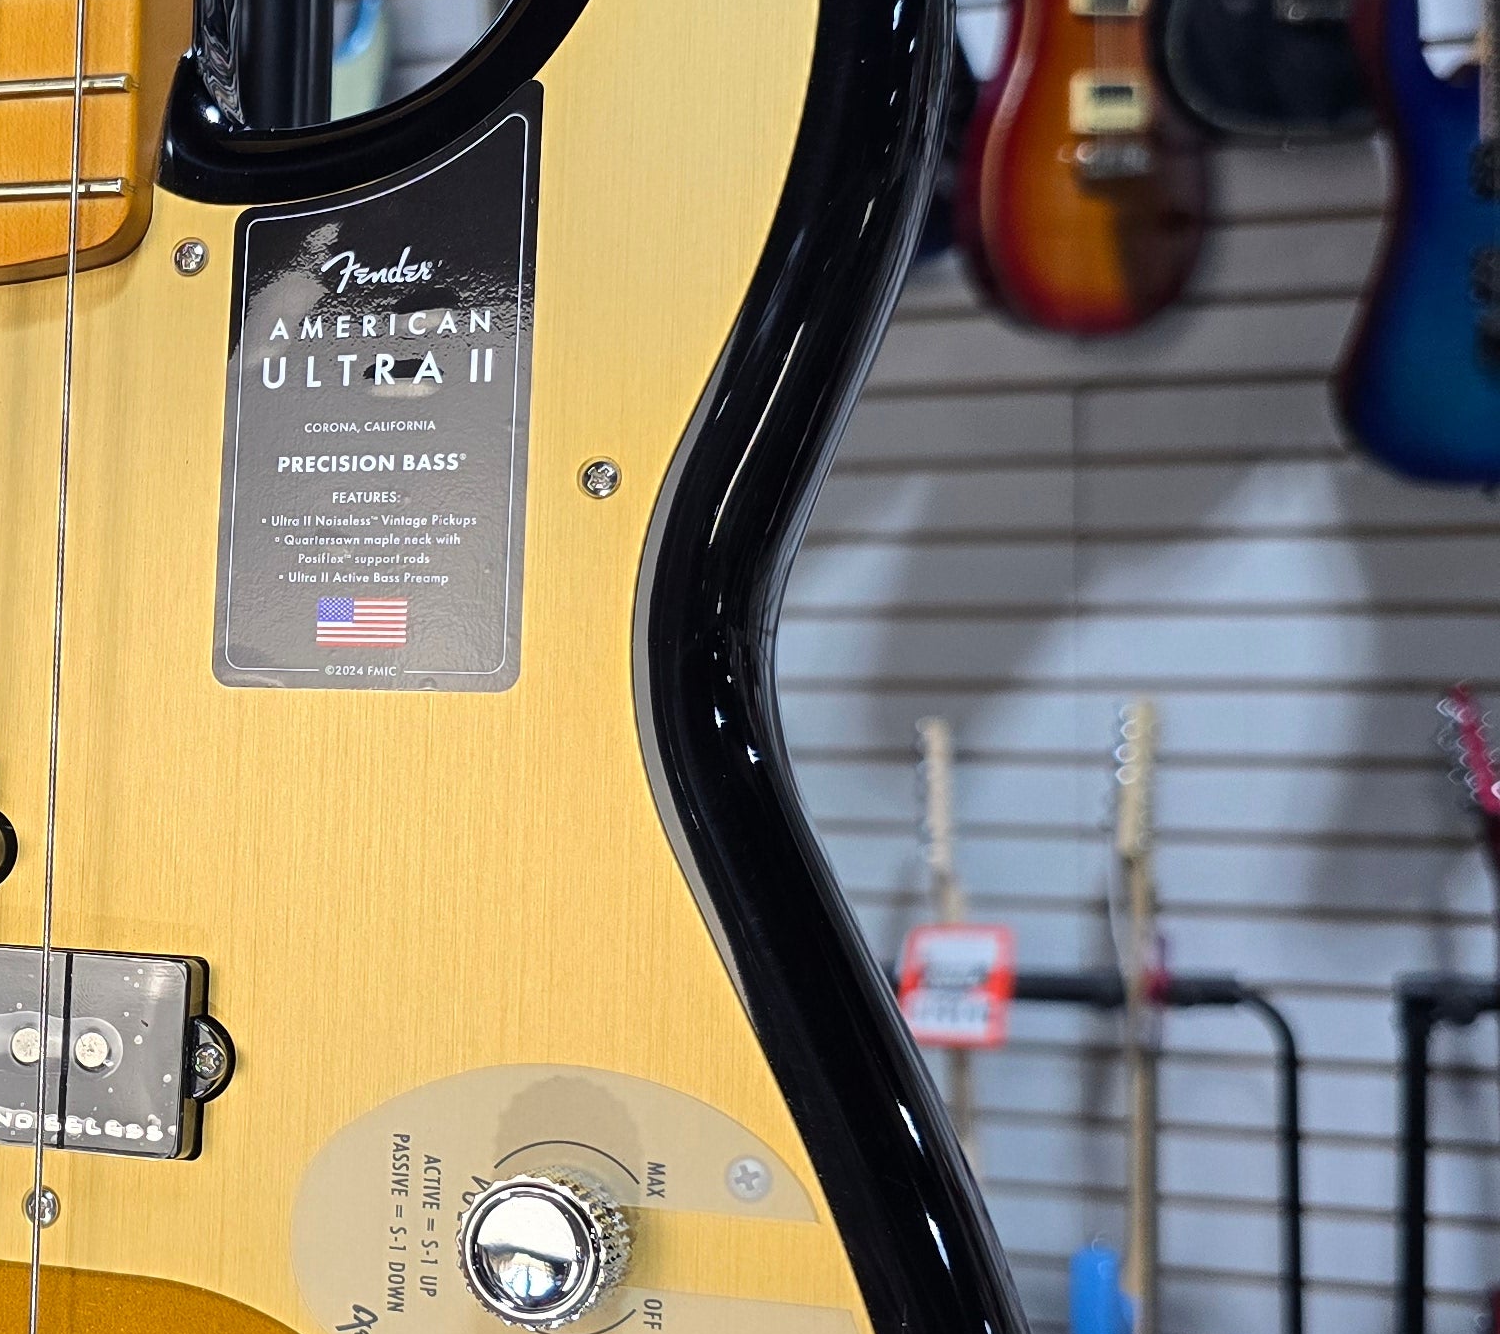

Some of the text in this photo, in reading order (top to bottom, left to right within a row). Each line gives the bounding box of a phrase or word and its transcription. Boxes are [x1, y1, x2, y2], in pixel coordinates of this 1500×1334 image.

[320, 245, 433, 294] Fender
[269, 309, 492, 341] AMERICAN
[262, 348, 494, 390] ULTRA II
[304, 420, 437, 434] CORONA, CALIFORNIA
[277, 454, 395, 473] PRECISION
[332, 491, 401, 504] FEATURES:
[271, 514, 300, 527] Ultra
[380, 514, 428, 528] Vintage
[432, 513, 477, 528] Pickups
[283, 533, 461, 548] Quartersawn maple neck with
[354, 554, 400, 566] support
[403, 553, 431, 564] rods
[288, 571, 317, 583] Ultra
[332, 571, 370, 583] Active
[373, 572, 400, 583] Bass
[403, 572, 449, 586] Preamp
[367, 666, 397, 677] FMIC
[391, 1133, 411, 1197] PASSIVE
[422, 1153, 442, 1211] ACTIVE
[646, 1161, 666, 1198] MAX
[388, 1225, 408, 1252] S-1
[420, 1239, 439, 1265] S-1
[386, 1261, 406, 1313] DOWN
[419, 1274, 438, 1298] UP
[643, 1298, 663, 1331] OFF
